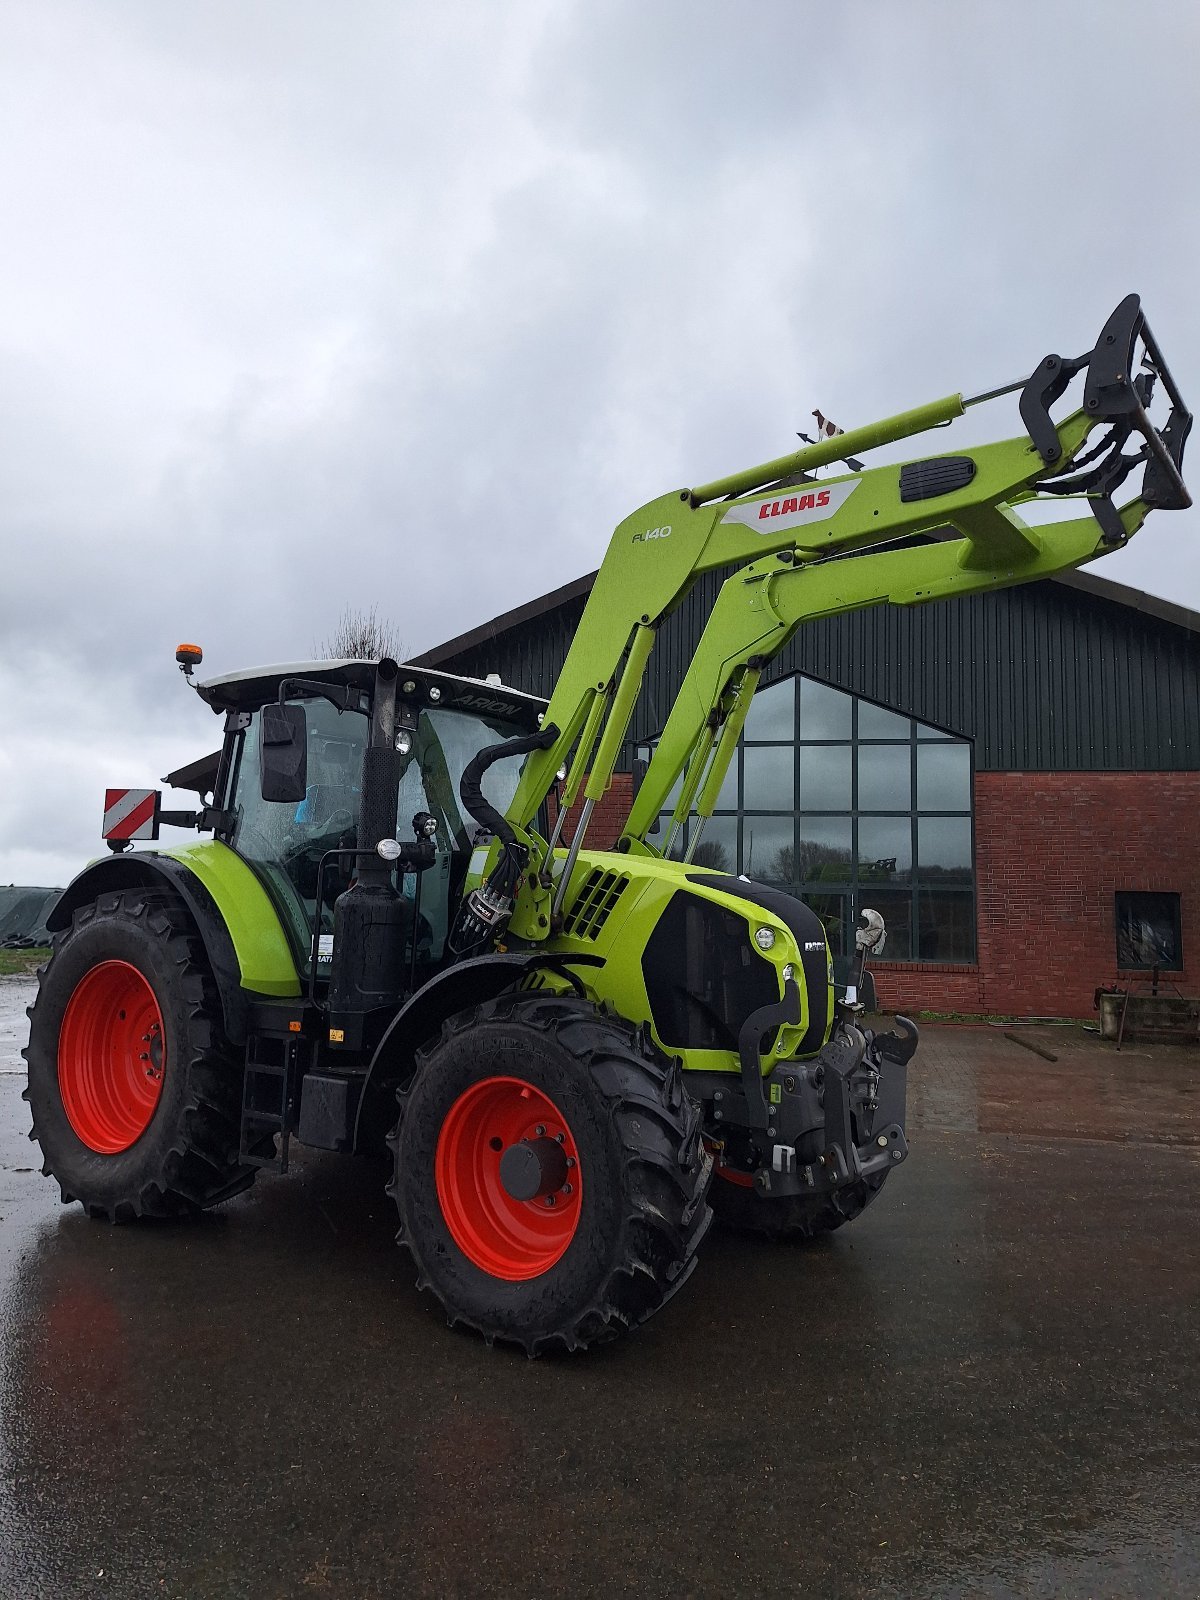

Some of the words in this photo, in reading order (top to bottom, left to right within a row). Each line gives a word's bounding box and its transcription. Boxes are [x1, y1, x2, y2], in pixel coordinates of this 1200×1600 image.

[759, 490, 831, 519] CLAAS
[631, 525, 672, 543] FL140
[452, 694, 522, 715] ARION
